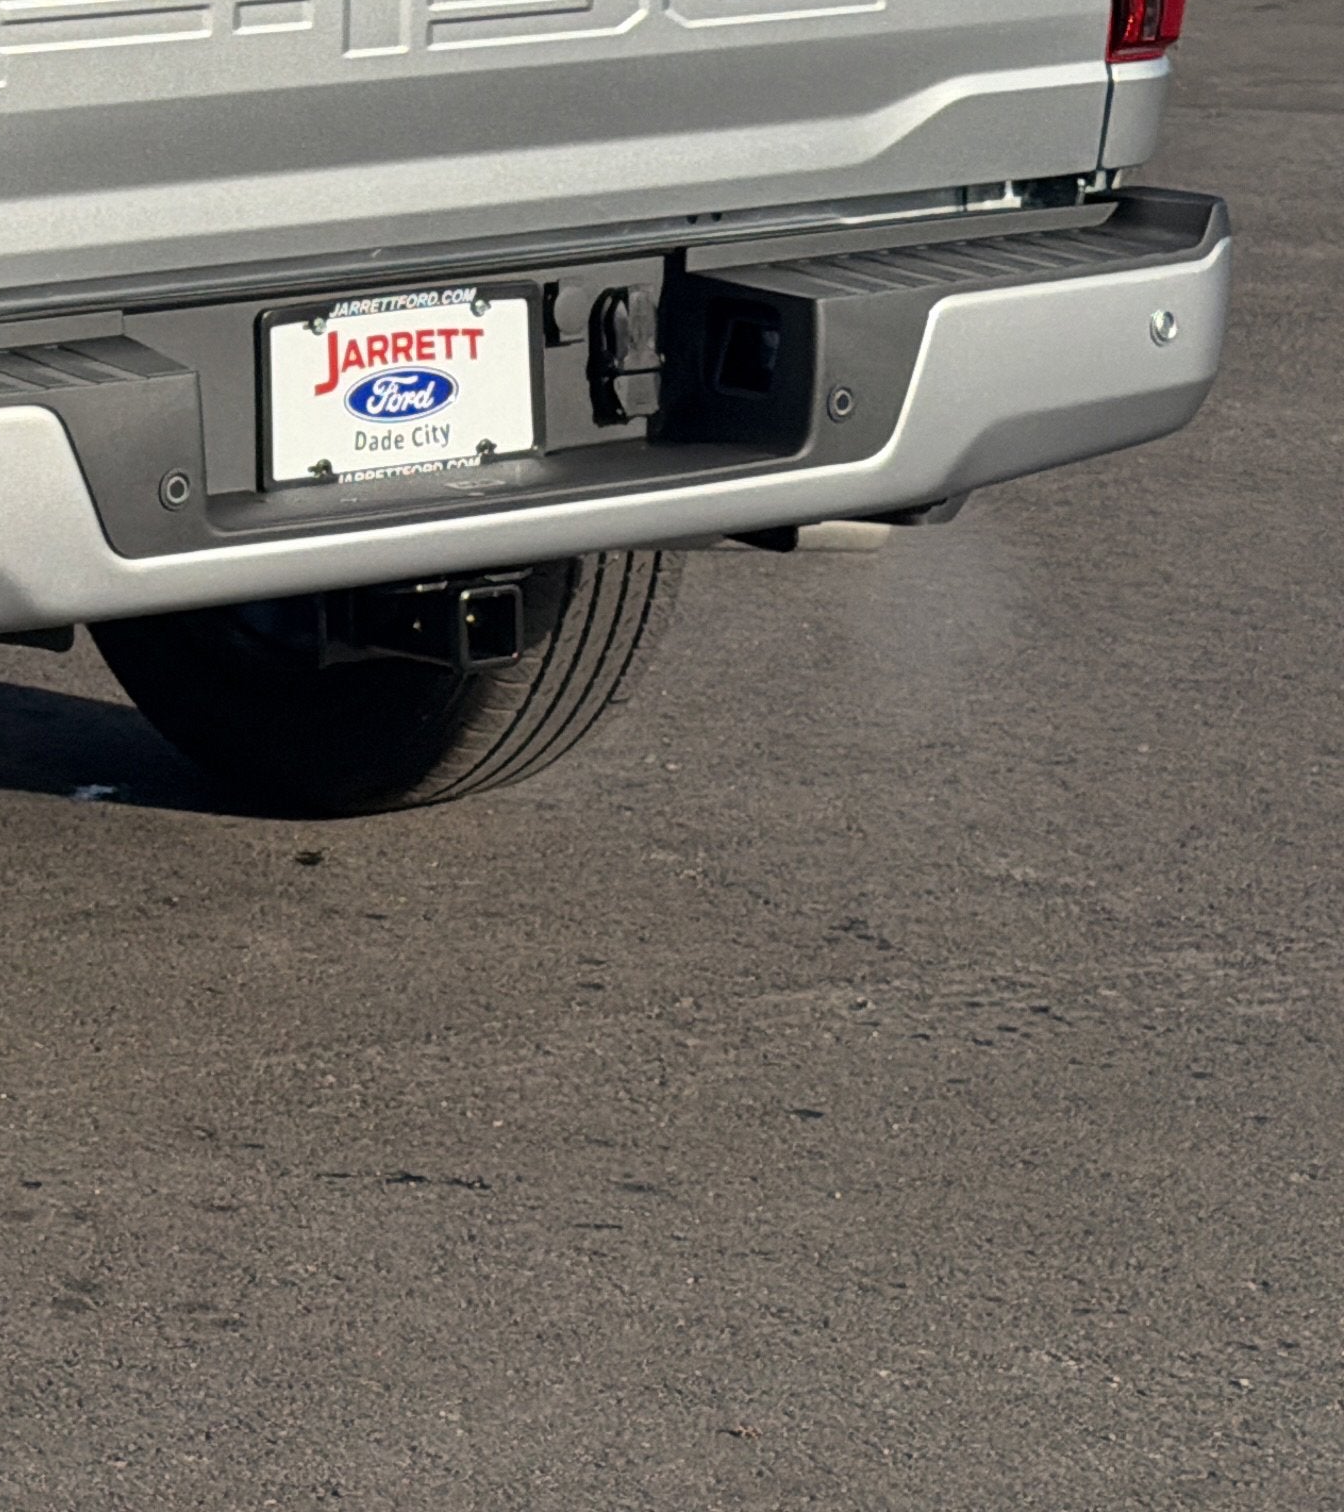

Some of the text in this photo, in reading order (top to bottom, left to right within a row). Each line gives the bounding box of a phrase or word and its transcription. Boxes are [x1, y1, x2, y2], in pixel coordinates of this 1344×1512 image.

[329, 287, 477, 318] JARRETTFORD.COM
[314, 328, 484, 396] JARRETT
[366, 375, 435, 414] Ford
[354, 424, 451, 451] Dade City
